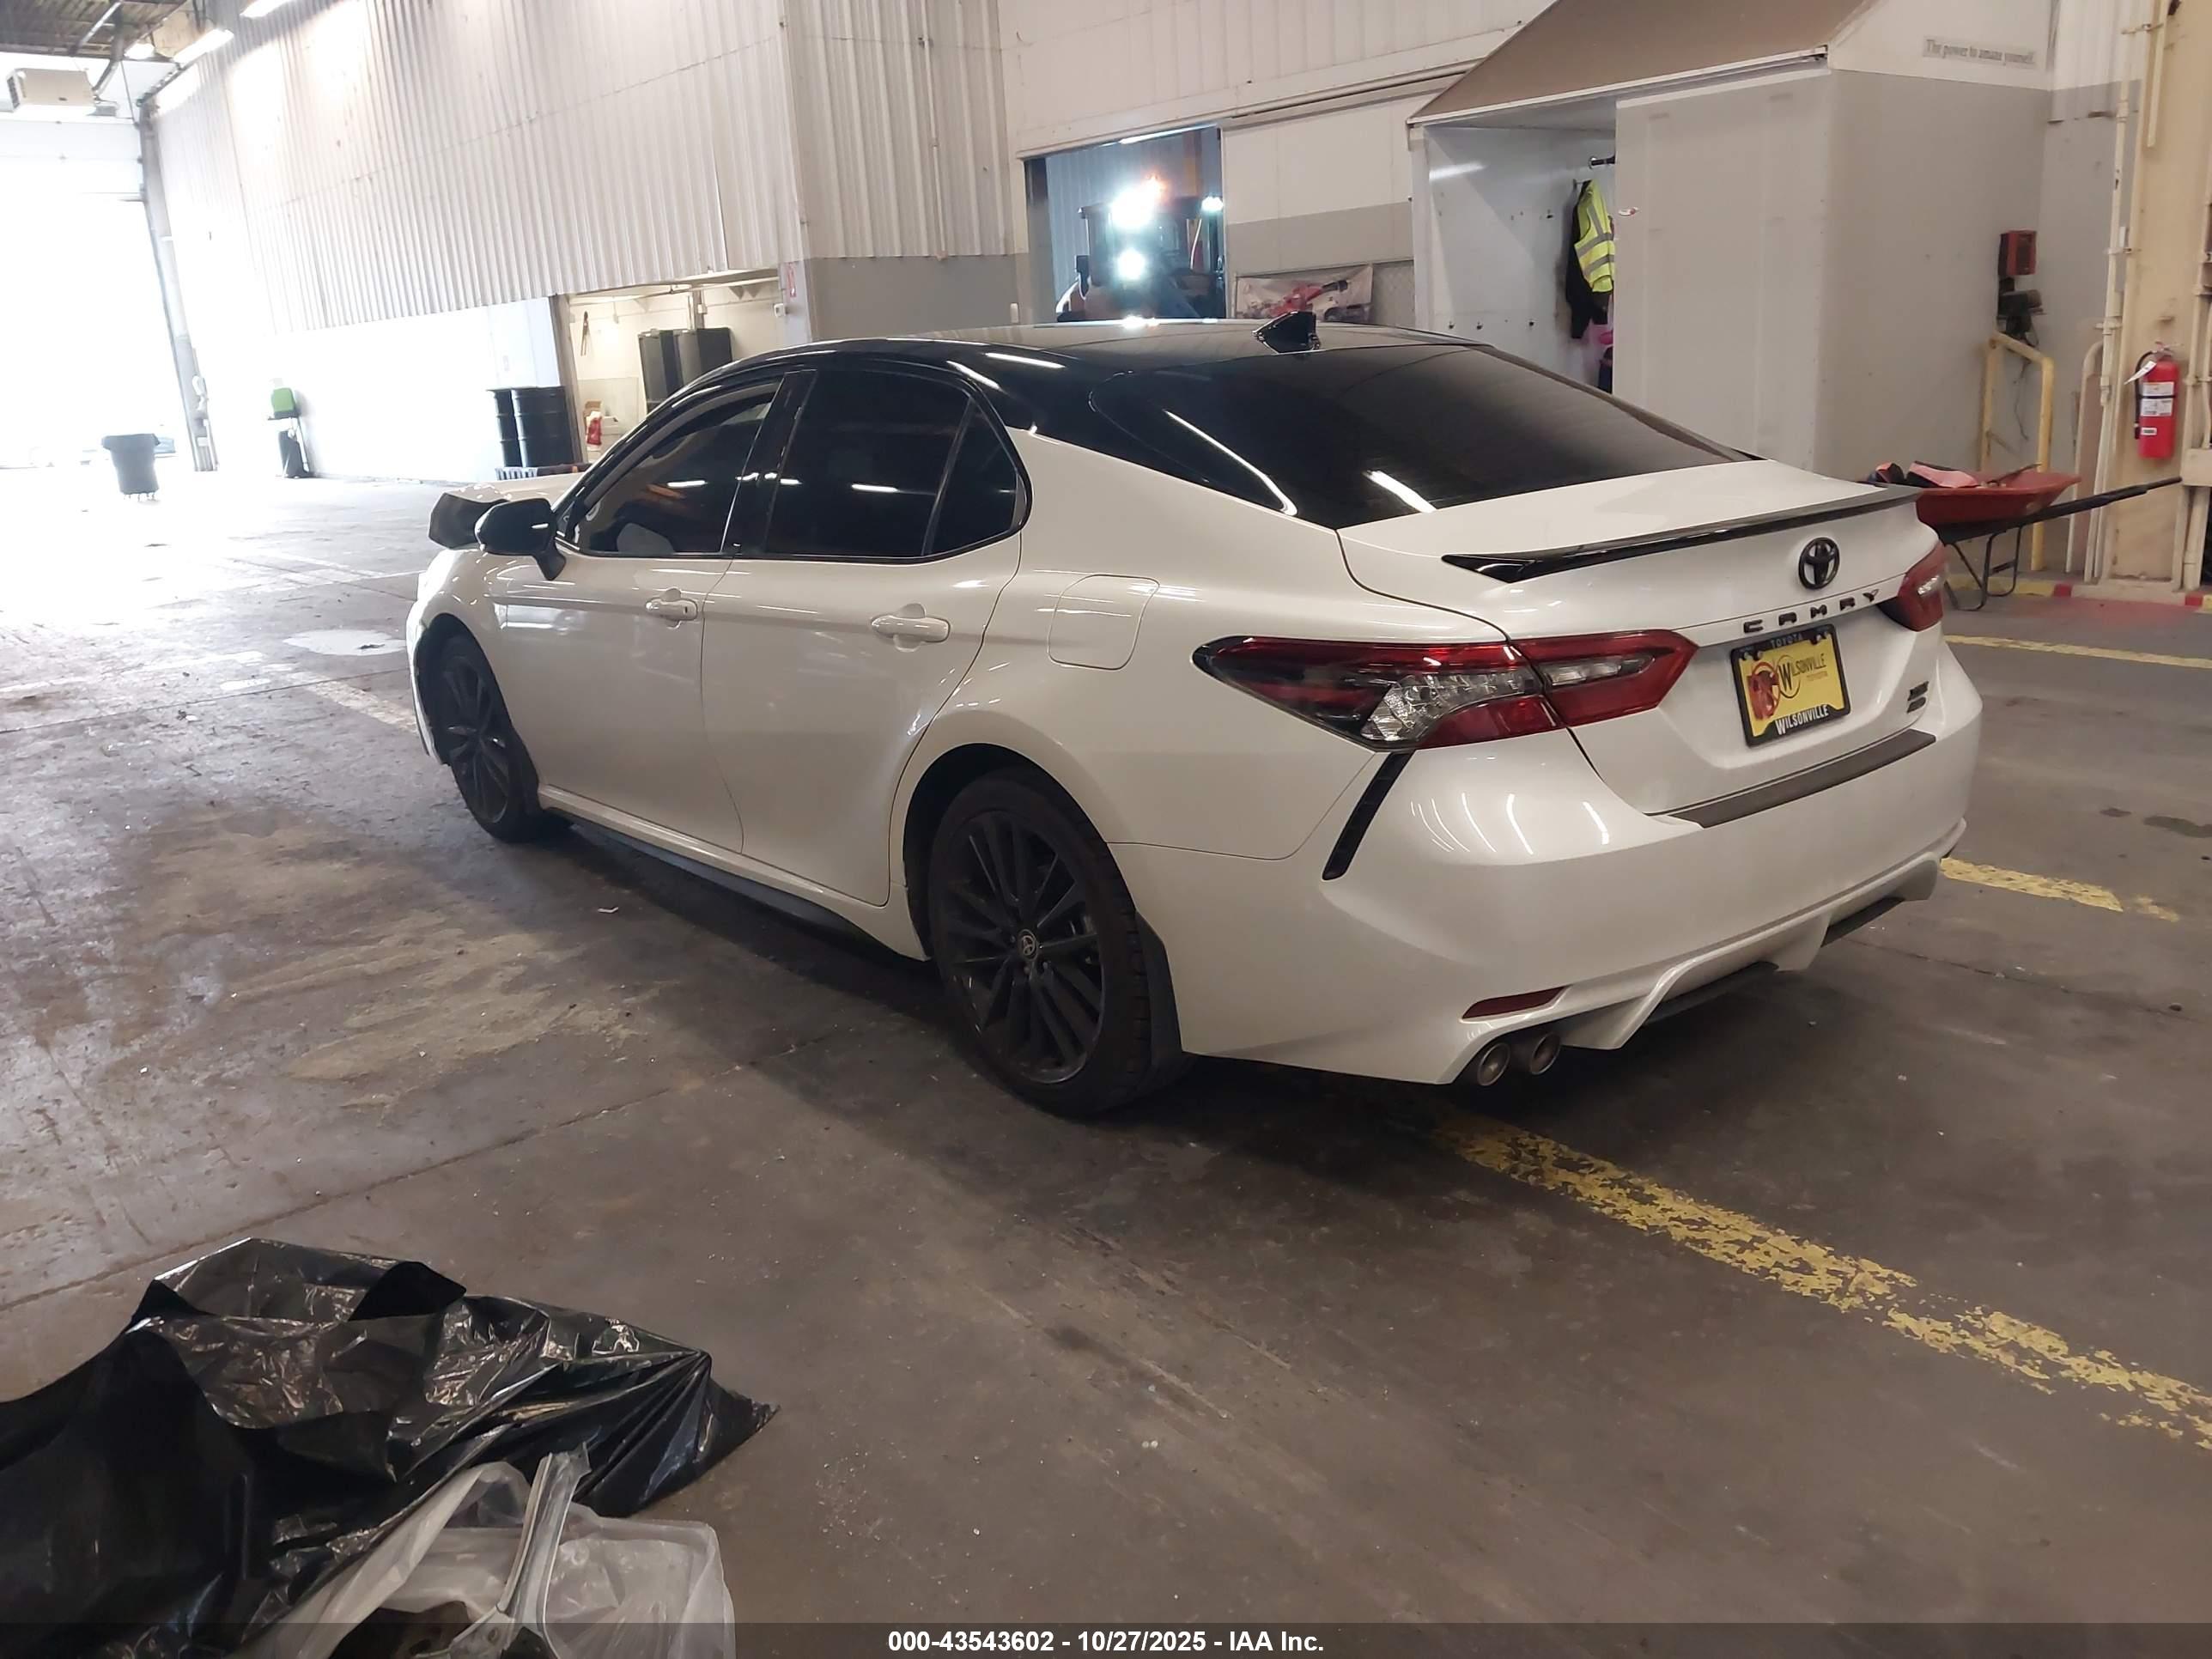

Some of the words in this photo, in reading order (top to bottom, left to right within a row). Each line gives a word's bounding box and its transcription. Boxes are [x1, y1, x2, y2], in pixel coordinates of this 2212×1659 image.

[1743, 588, 1880, 634] CAMRY
[1770, 633, 1804, 649] TOYOTA
[1775, 704, 1829, 736] WILSONVILLE
